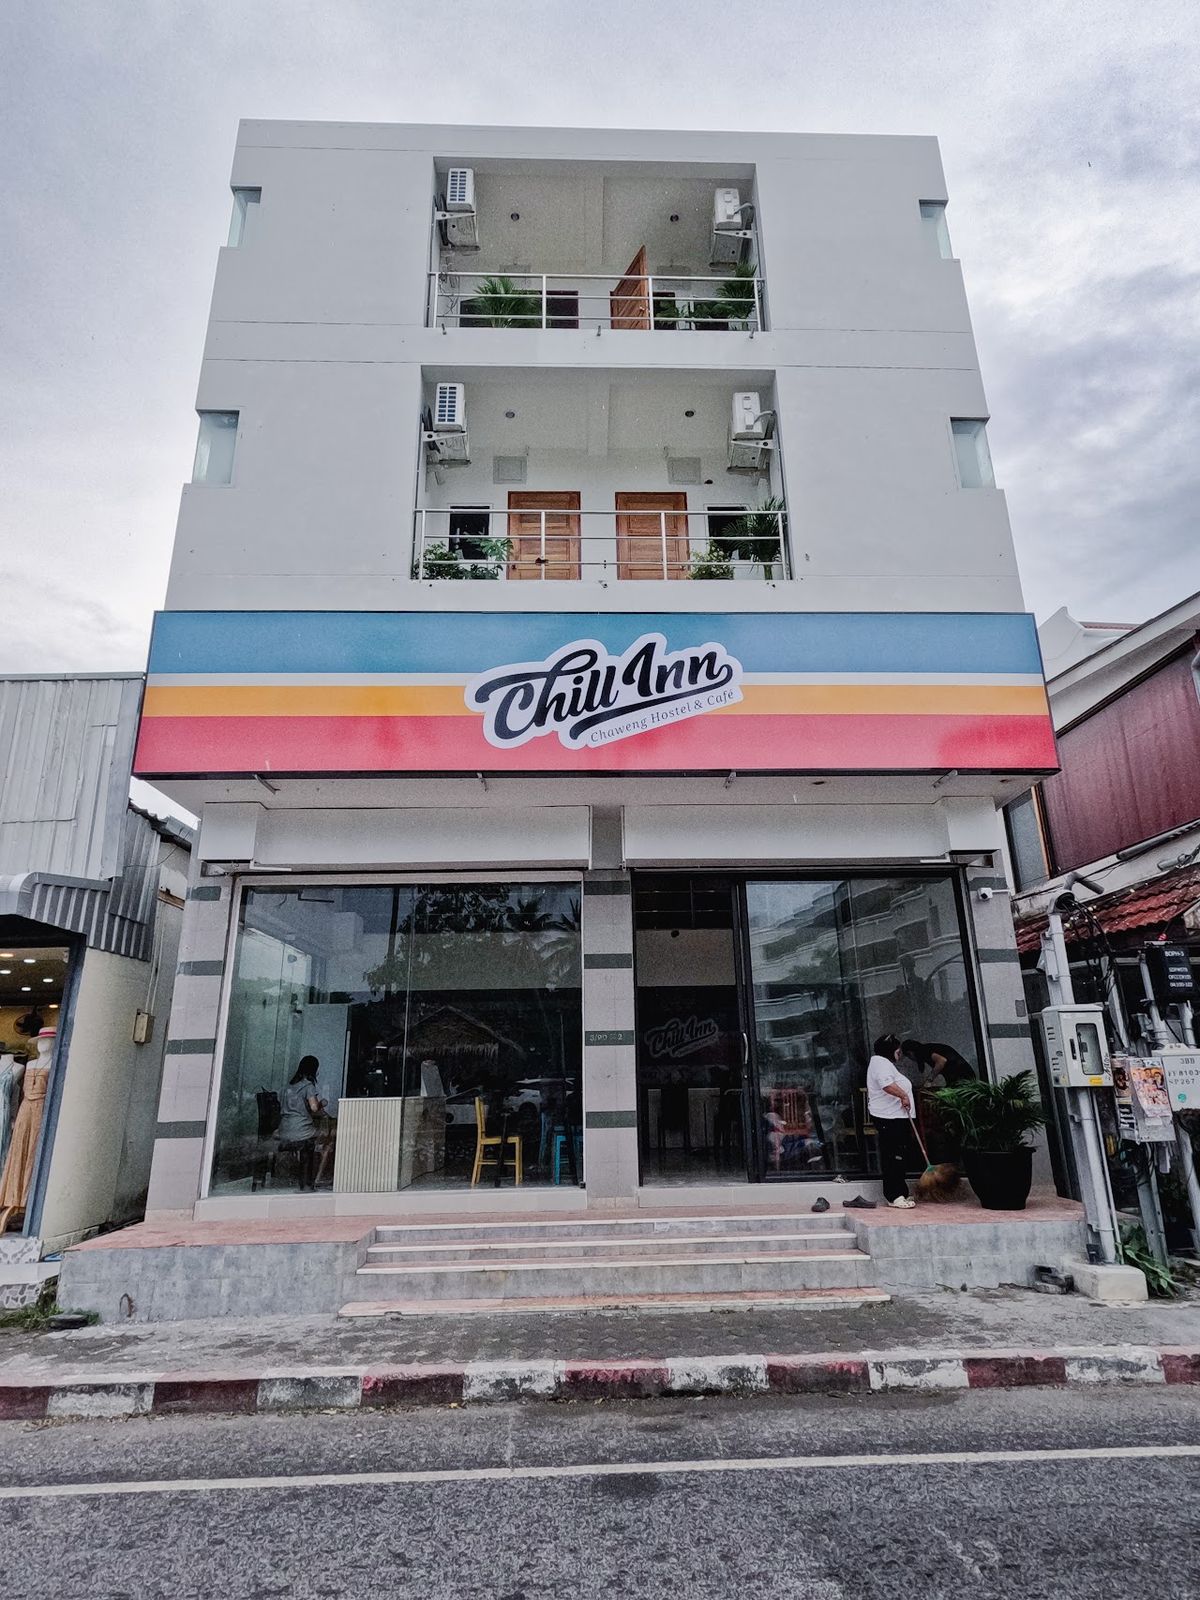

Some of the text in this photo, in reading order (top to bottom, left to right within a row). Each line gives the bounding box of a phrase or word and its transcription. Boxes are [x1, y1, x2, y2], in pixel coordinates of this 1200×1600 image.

[474, 642, 733, 740] Chill Inn
[590, 688, 734, 742] Chaweng Hostel & Café
